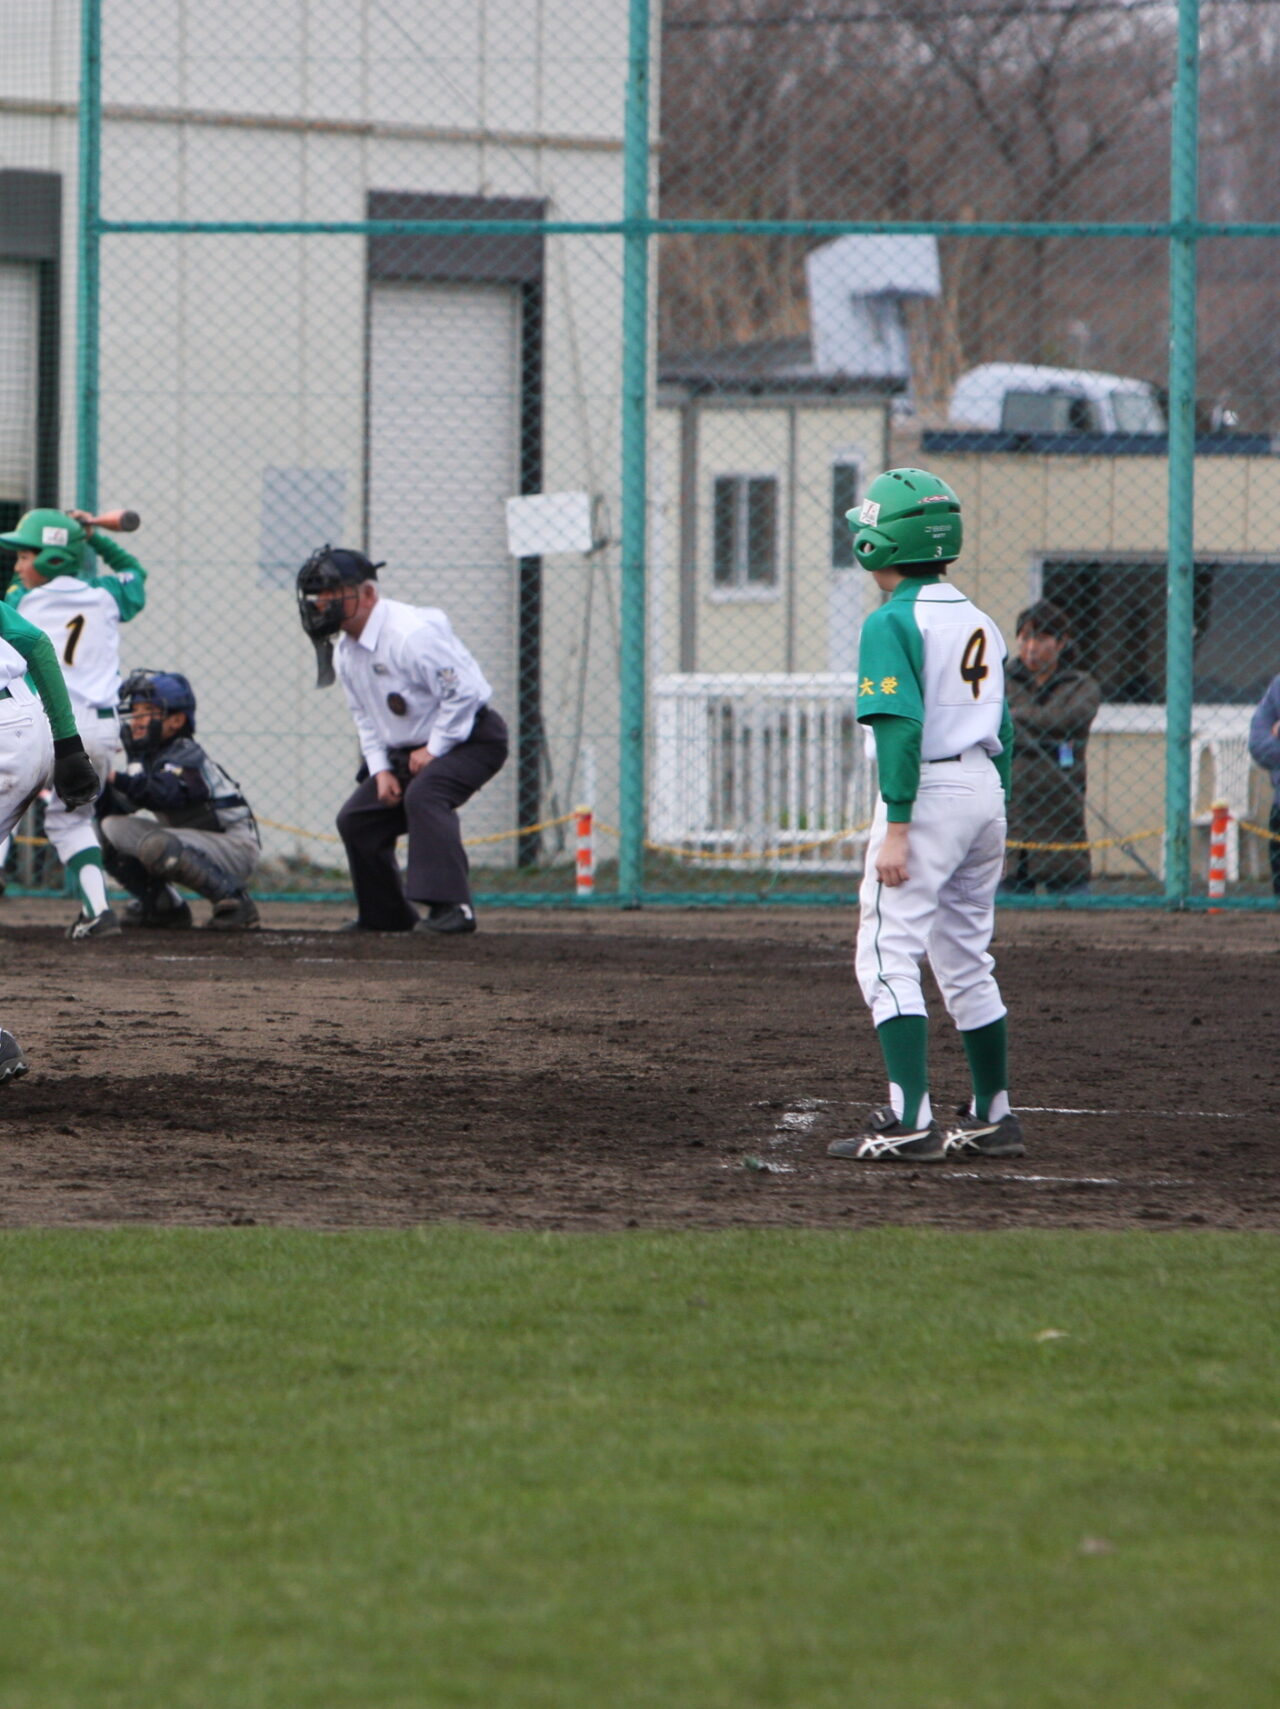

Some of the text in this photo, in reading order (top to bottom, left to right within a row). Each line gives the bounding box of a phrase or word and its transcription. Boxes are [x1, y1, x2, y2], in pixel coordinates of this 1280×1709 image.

[933, 545, 943, 559] 3
[64, 613, 86, 666] 1
[960, 627, 989, 700] 4
